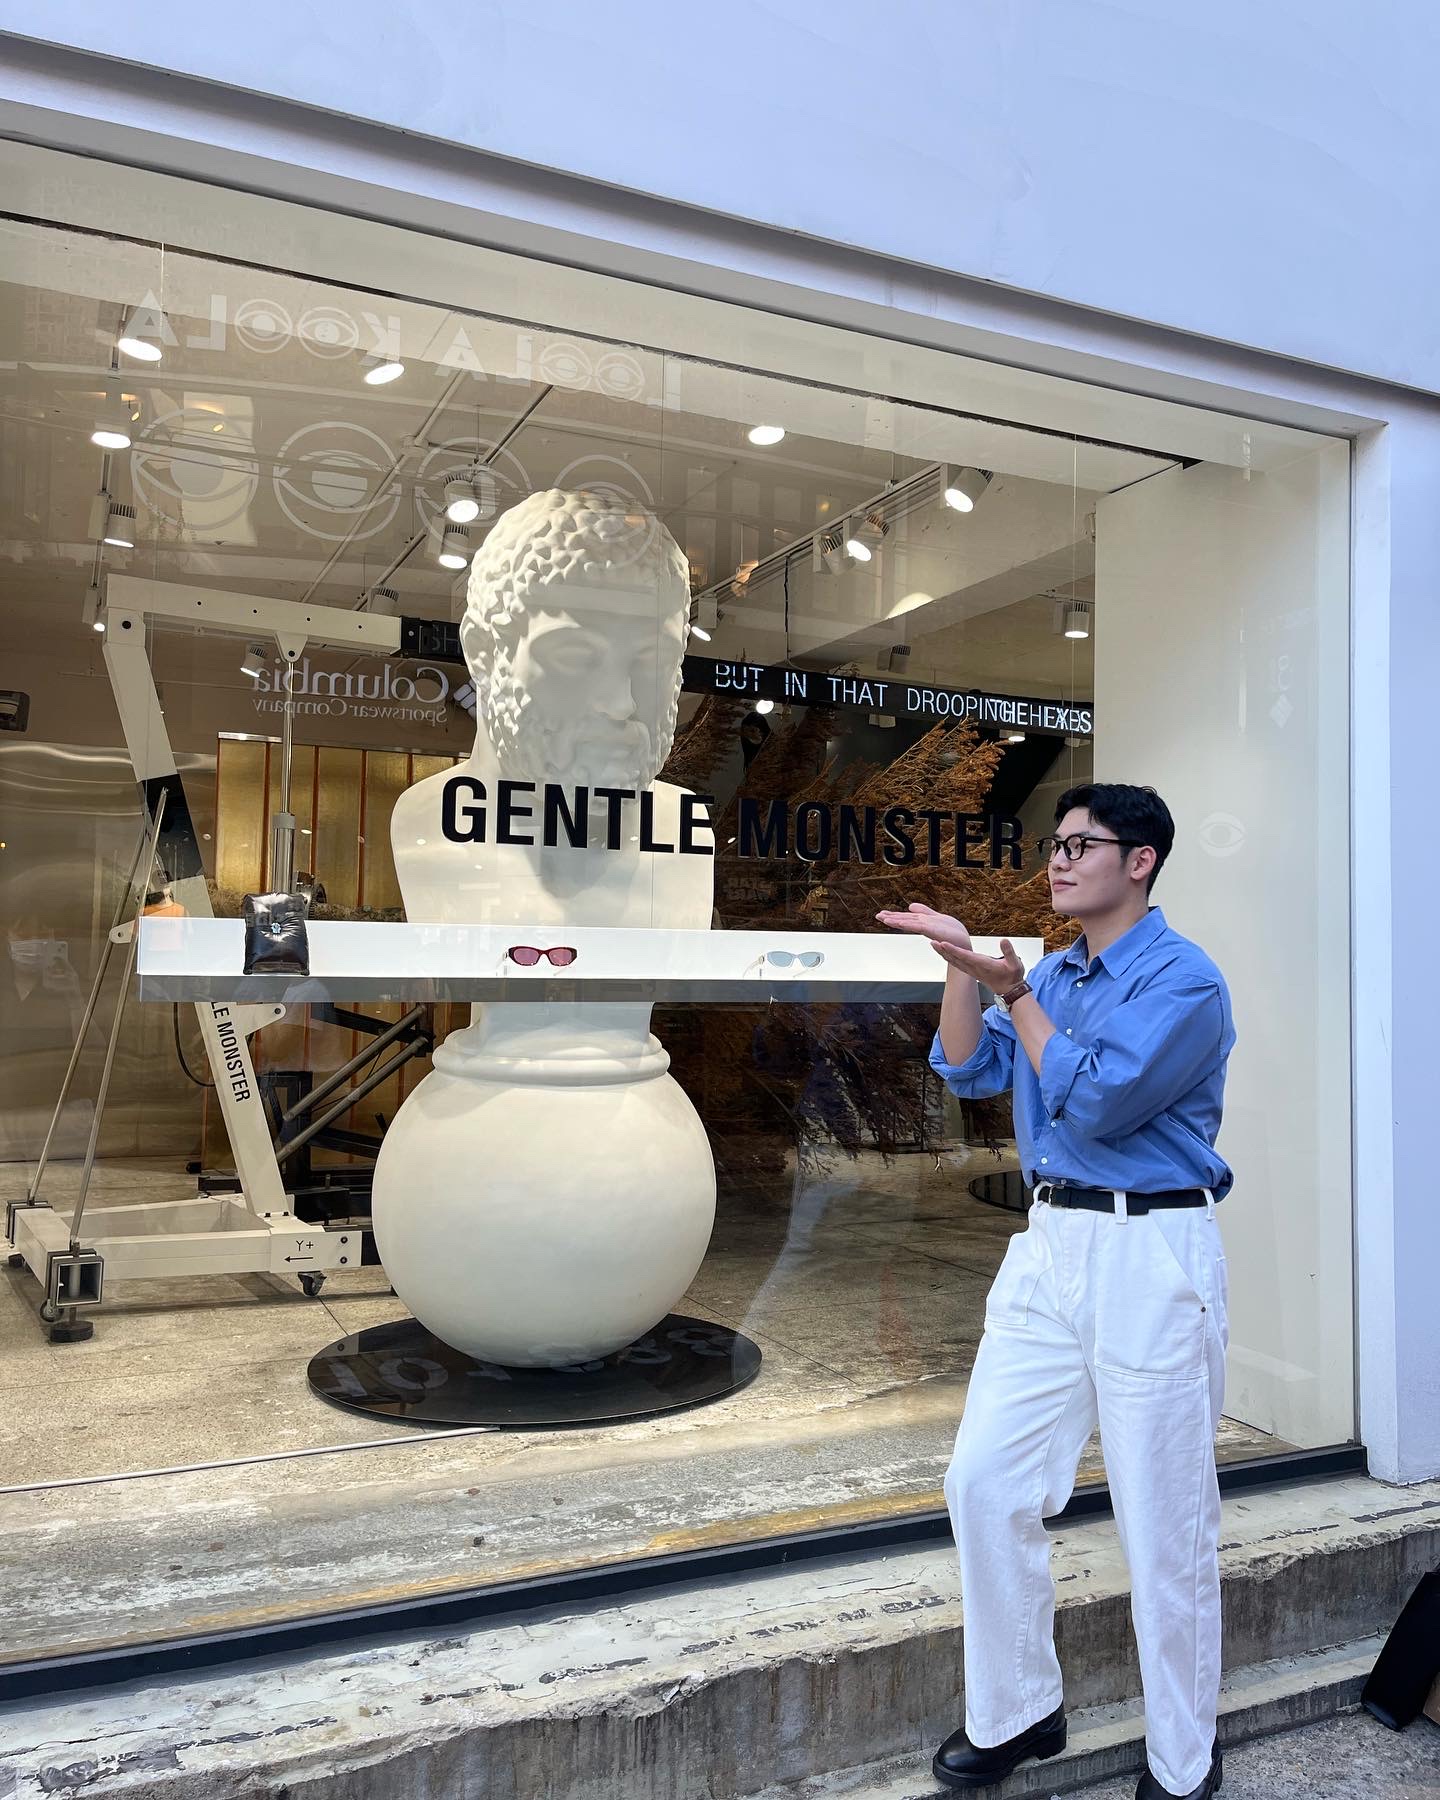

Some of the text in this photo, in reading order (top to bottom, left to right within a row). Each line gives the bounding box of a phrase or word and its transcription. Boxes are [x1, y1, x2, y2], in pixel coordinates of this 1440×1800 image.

[715, 663, 764, 692] BUT
[785, 671, 807, 698] IN
[827, 677, 889, 707] THAT
[441, 775, 1024, 871] GENTLE MONSTER
[216, 1021, 251, 1102] MONSTER
